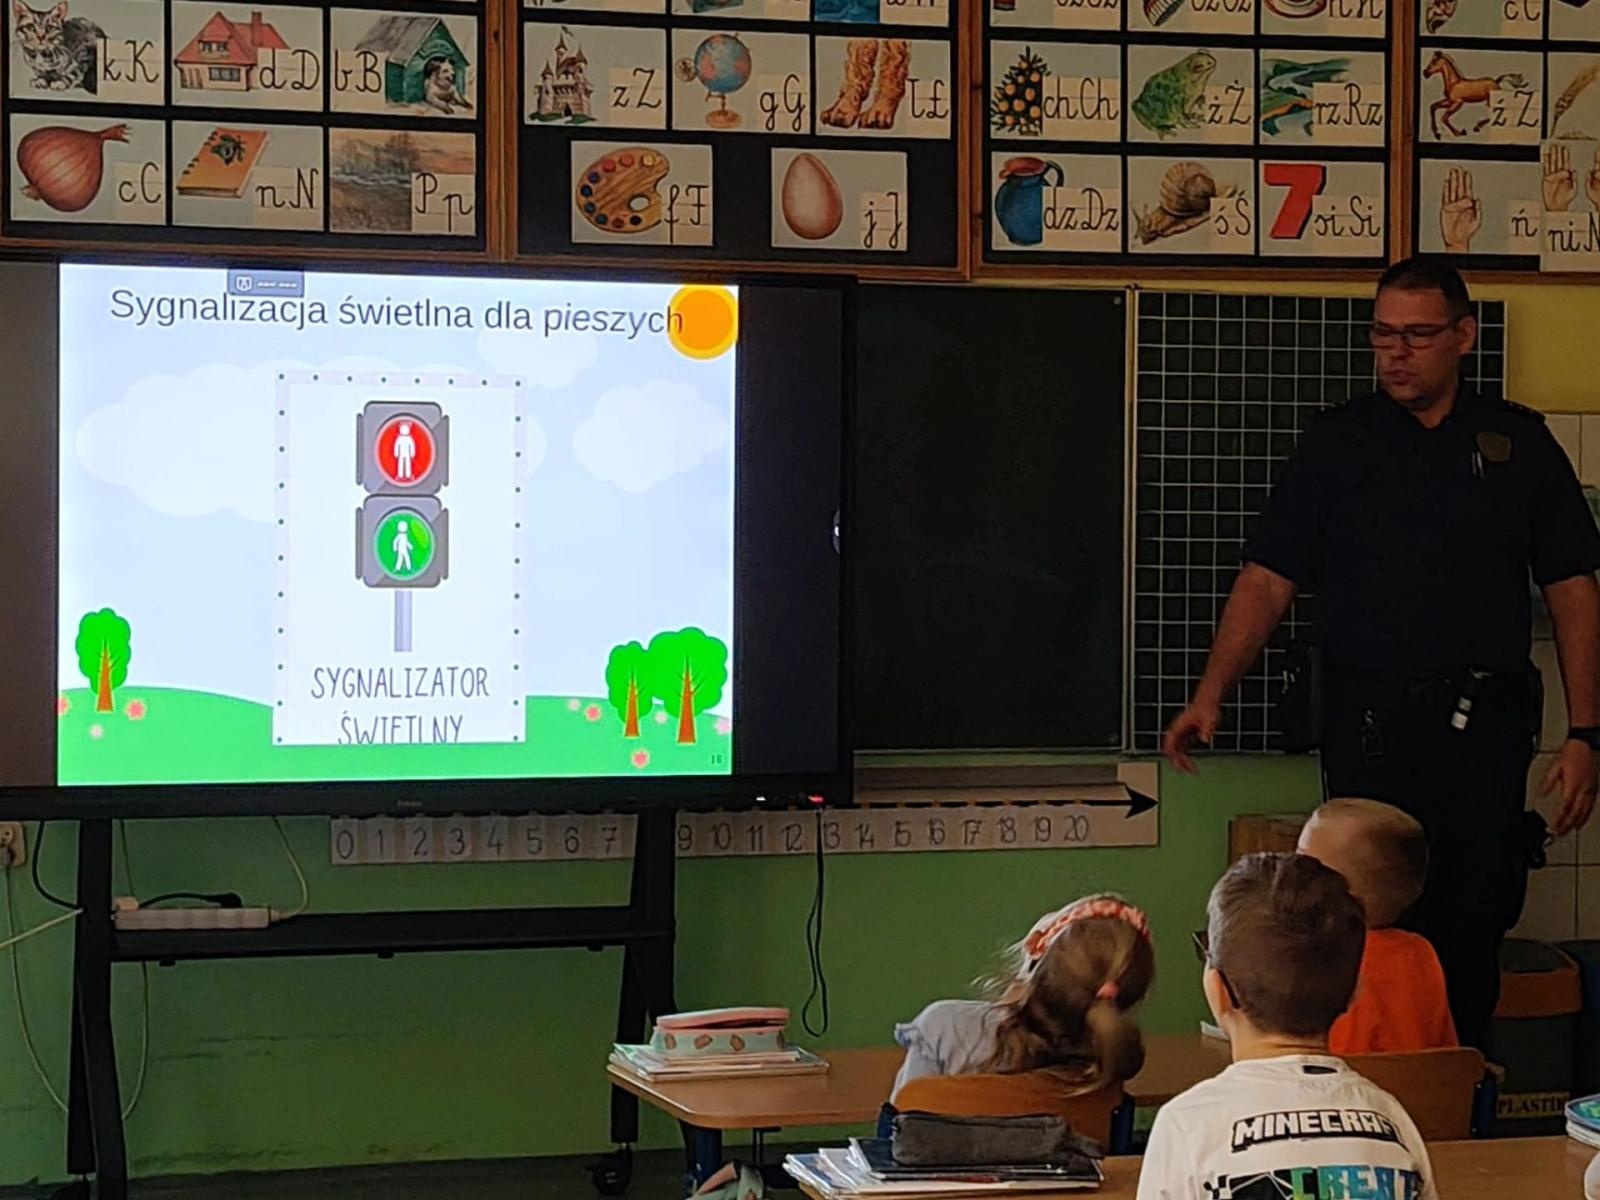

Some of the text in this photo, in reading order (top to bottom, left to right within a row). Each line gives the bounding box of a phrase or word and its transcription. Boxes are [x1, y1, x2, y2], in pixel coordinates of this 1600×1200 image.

[111, 289, 684, 340] Sygnalizacja świetlna dla pieszych
[311, 666, 490, 699] SYGNALIZATOR
[336, 829, 354, 860] 0
[375, 828, 384, 856] 1
[412, 827, 428, 856] 2
[450, 828, 466, 855] 3
[487, 826, 503, 856] 4
[527, 828, 542, 855] 5
[564, 827, 579, 854] 6
[602, 827, 617, 854] 7
[677, 824, 693, 850] 9
[713, 822, 732, 850] 10
[747, 825, 763, 852] 11
[781, 823, 803, 852] 12
[853, 822, 874, 849] 14
[894, 821, 911, 847] 15
[928, 818, 946, 845] 16
[964, 819, 982, 845] 17
[996, 817, 1016, 843] 18
[1033, 816, 1051, 842] 19
[1064, 814, 1089, 842] 20
